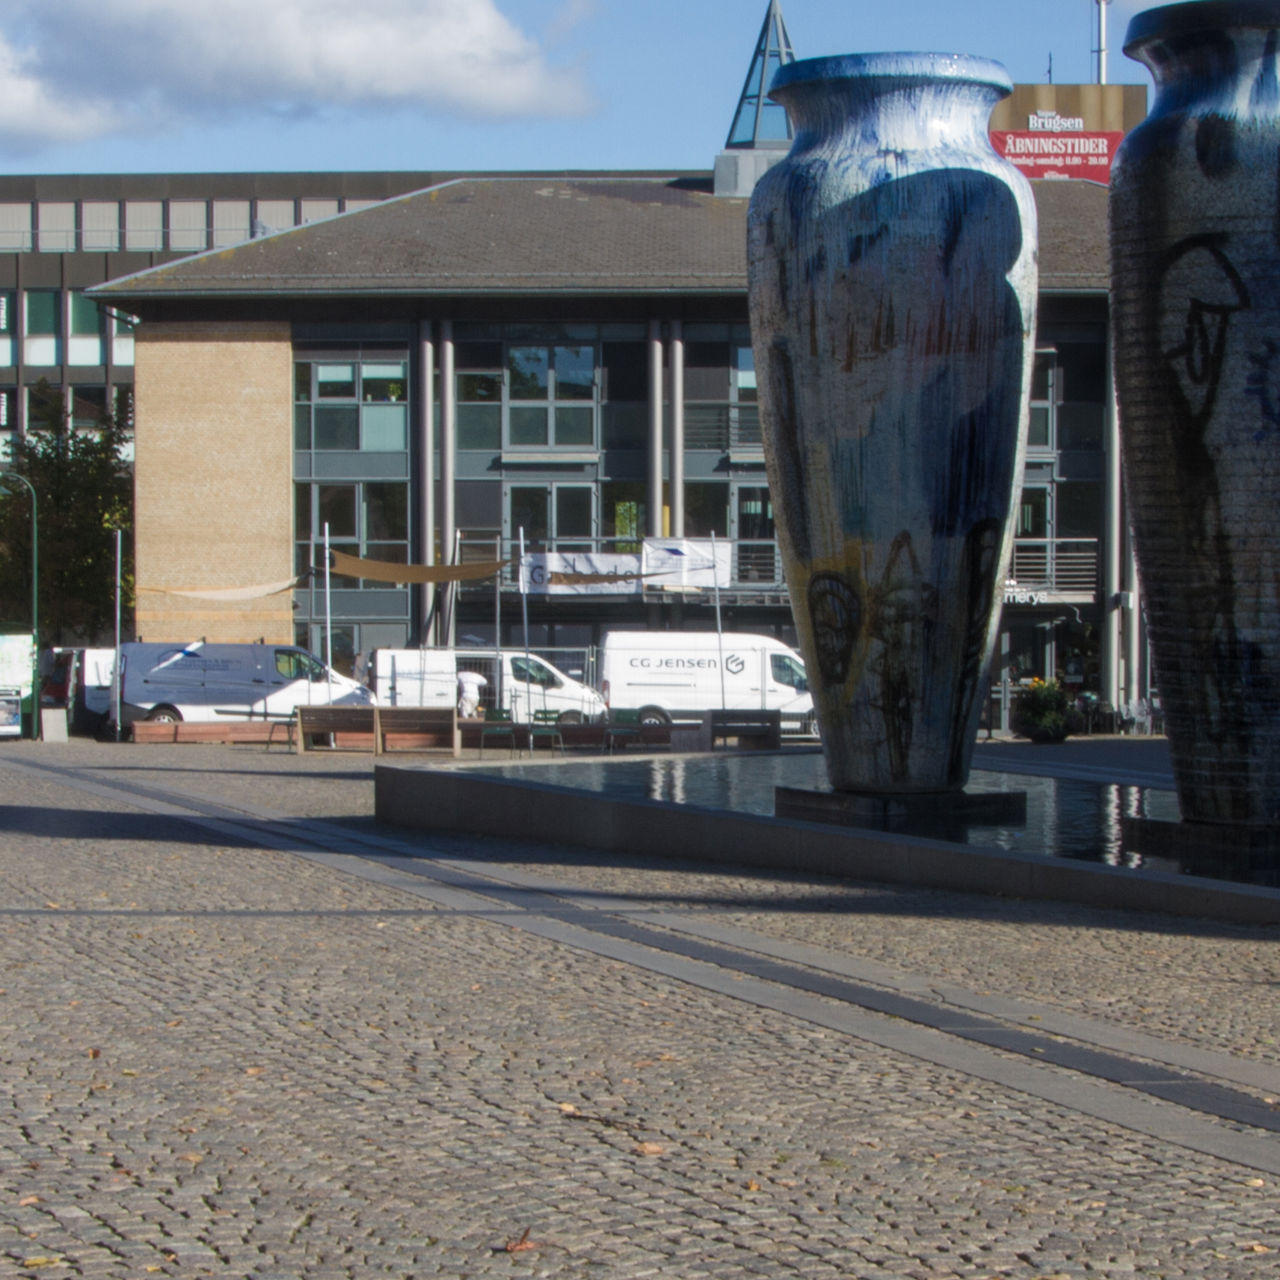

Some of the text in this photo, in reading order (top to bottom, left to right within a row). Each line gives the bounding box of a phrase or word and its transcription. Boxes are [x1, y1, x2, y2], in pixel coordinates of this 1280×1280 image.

[1028, 113, 1084, 133] Brugsen
[1004, 134, 1109, 154] ÅBNINGSTIDER
[629, 657, 651, 668] CG
